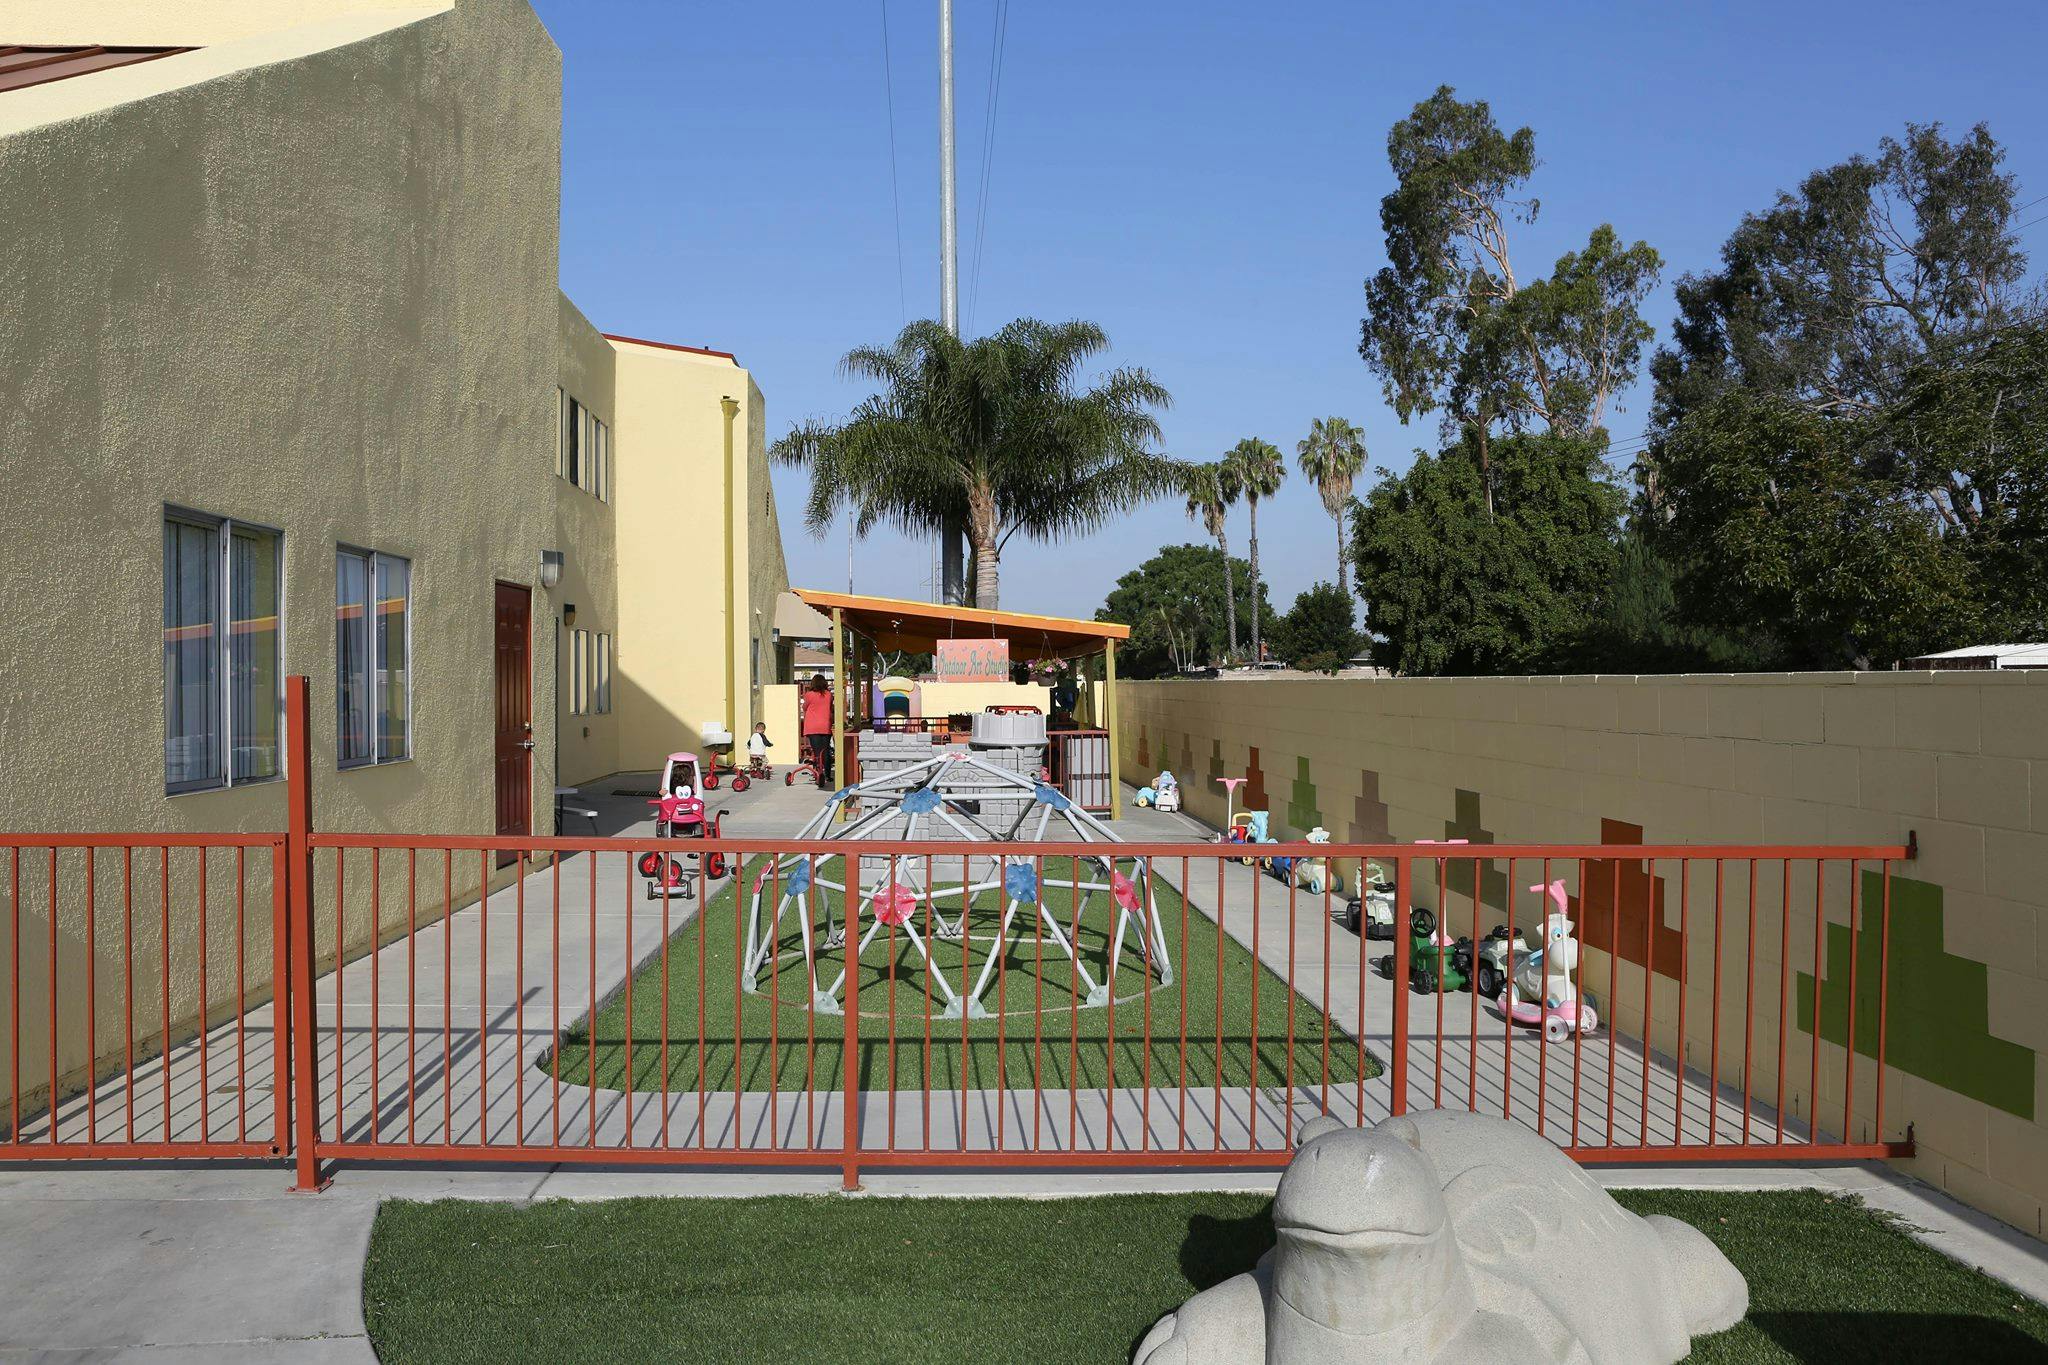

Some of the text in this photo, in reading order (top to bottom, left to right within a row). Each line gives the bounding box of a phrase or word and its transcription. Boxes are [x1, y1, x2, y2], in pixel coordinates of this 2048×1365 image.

[938, 650, 1008, 676] Outdoor Art Studio
